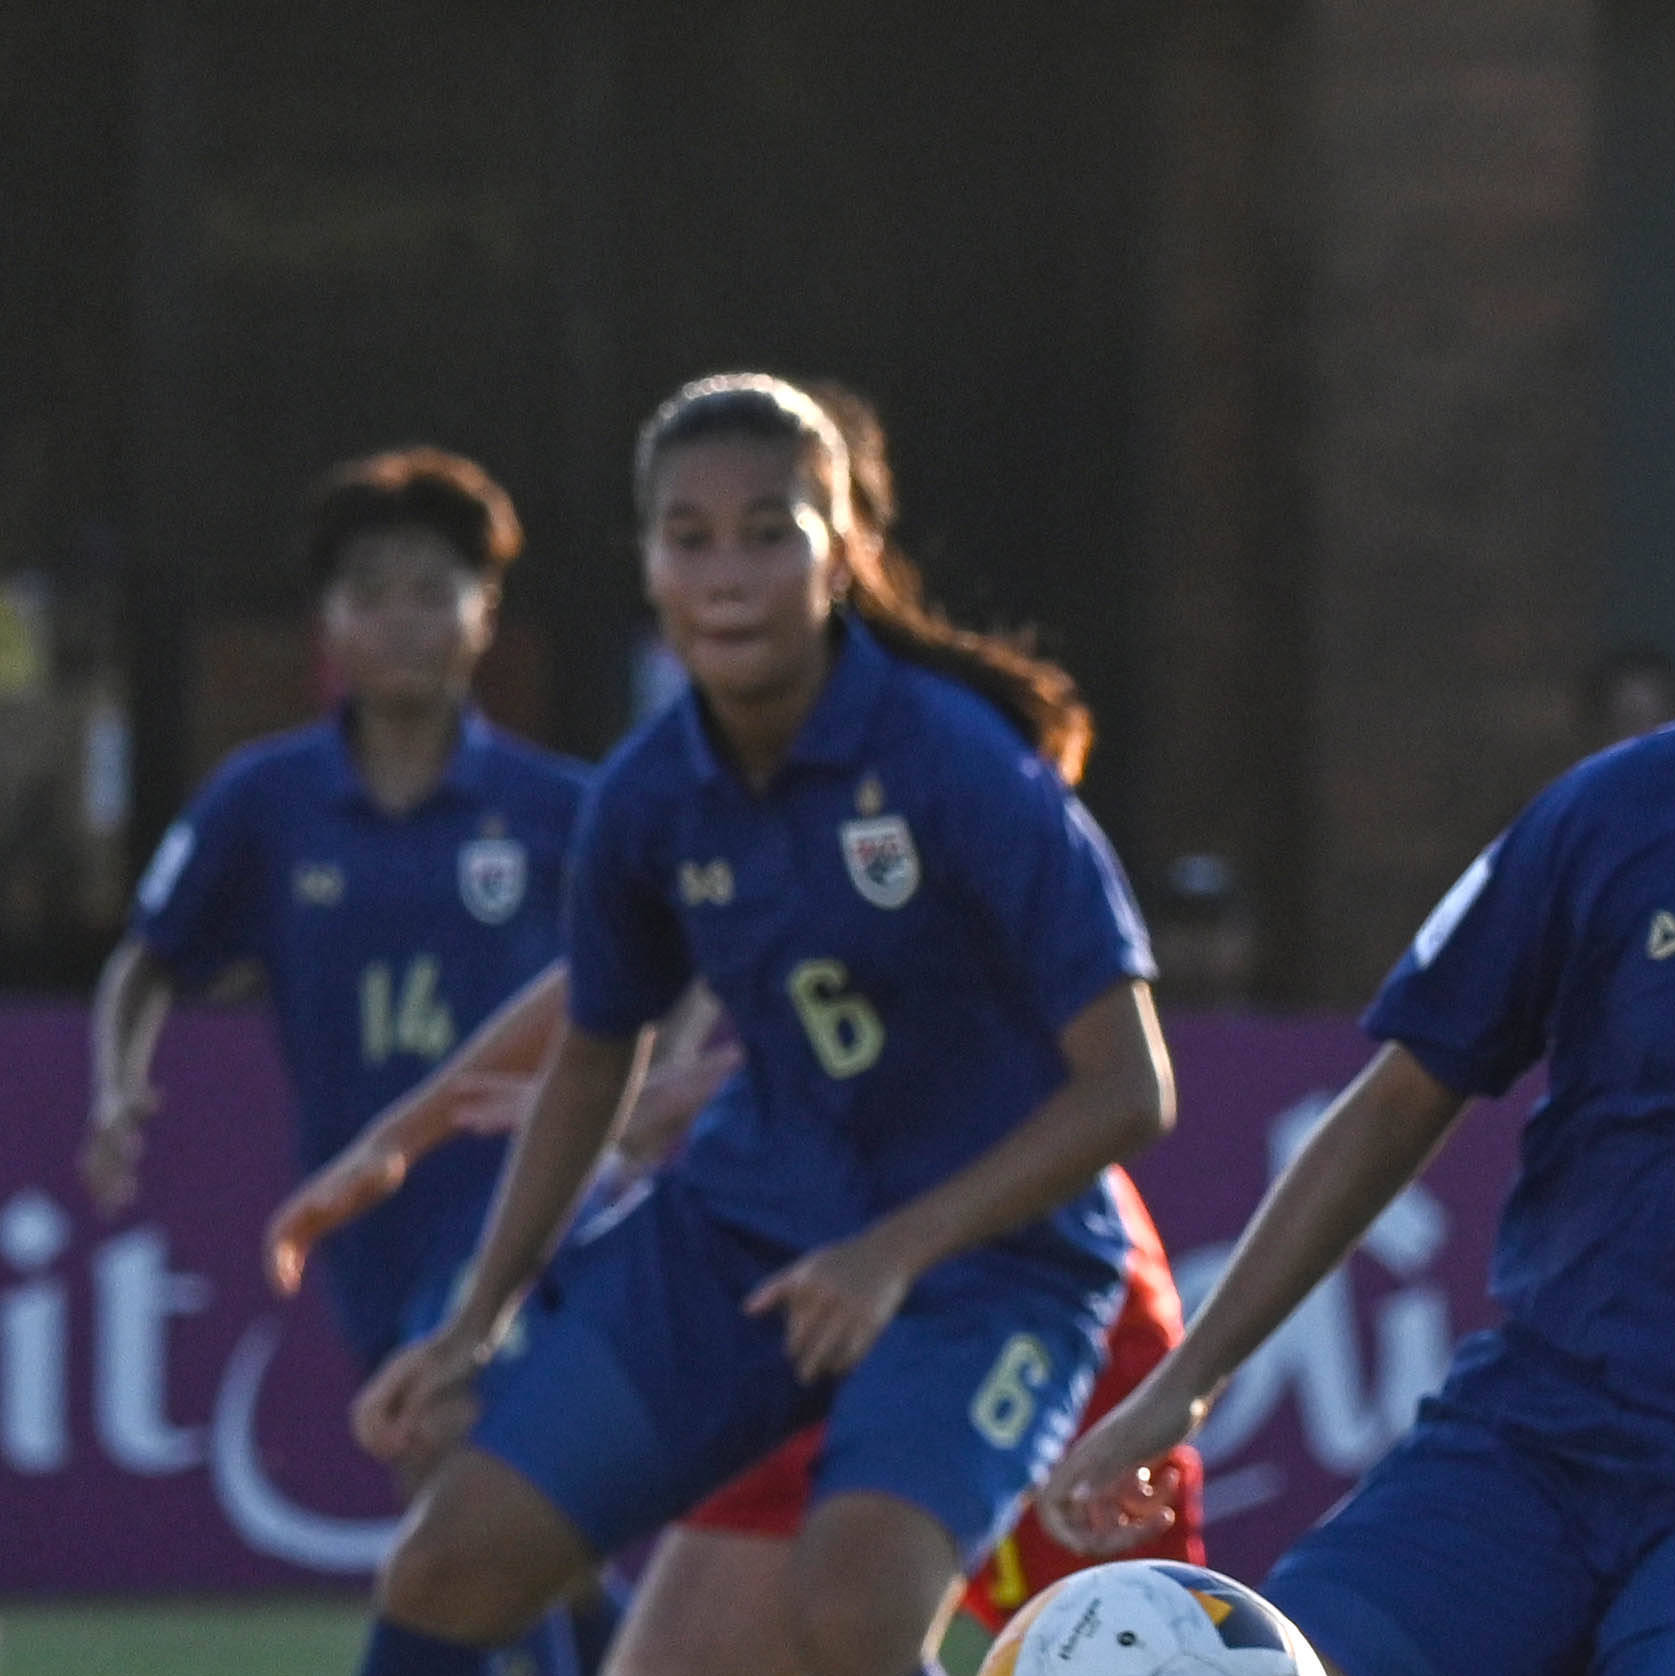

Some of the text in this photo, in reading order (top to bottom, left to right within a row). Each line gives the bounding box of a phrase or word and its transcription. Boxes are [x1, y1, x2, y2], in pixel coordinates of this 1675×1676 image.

[360, 957, 456, 1066] 14
[788, 957, 885, 1081] 6
[968, 1331, 1051, 1450] 6
